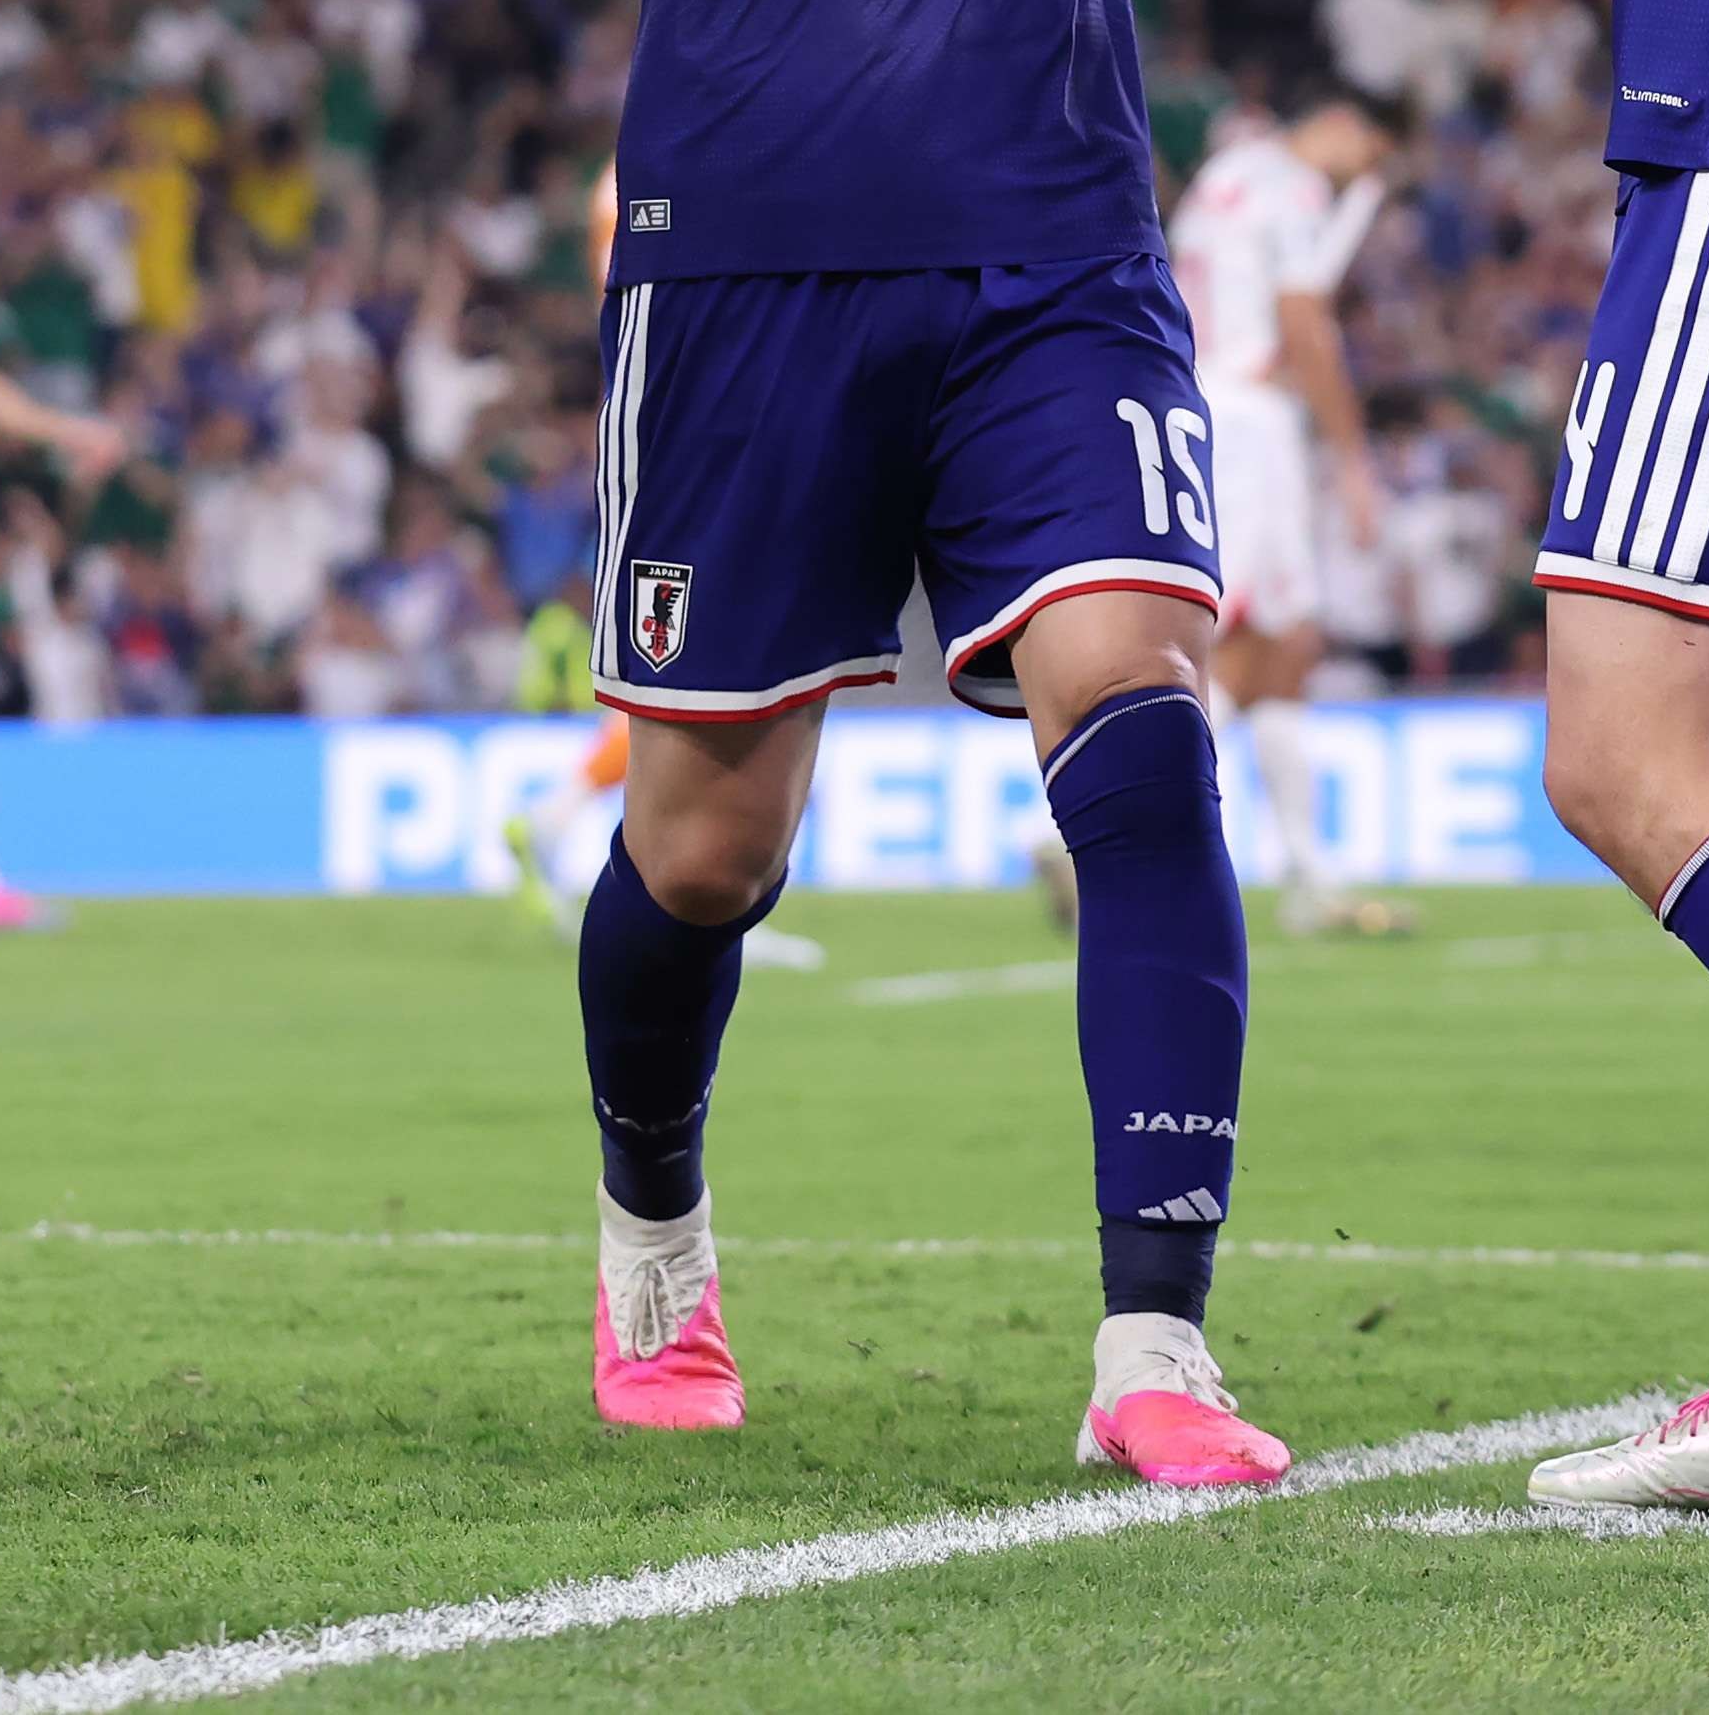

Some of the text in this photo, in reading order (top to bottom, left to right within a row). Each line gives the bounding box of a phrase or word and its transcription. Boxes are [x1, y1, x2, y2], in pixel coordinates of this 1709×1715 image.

[1116, 397, 1215, 551] 15
[648, 566, 681, 579] JAPAN
[1123, 1111, 1238, 1141] JAPA
